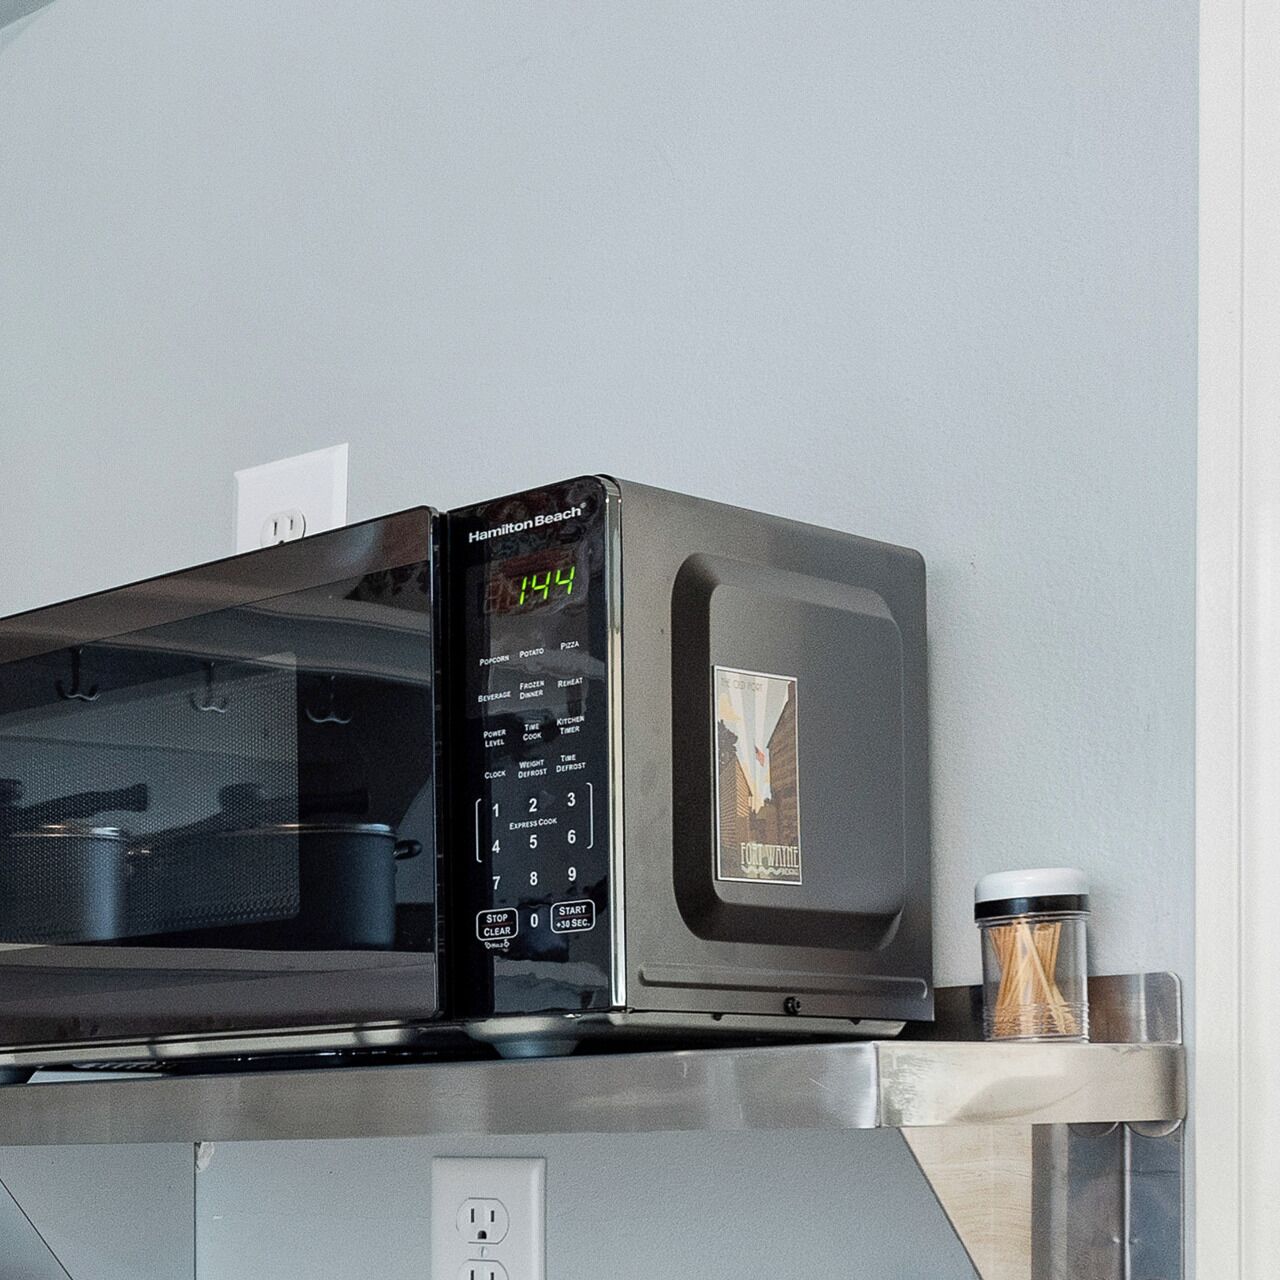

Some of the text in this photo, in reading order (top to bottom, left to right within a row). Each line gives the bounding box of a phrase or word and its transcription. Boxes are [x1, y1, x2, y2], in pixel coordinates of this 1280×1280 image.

[468, 506, 582, 543] Hamilton Beach
[561, 641, 579, 650] PIZZA
[520, 648, 544, 658] POTATO
[480, 655, 509, 666] POPCORN
[557, 678, 583, 688] REHEAT
[478, 691, 511, 702] BEVERAGE
[557, 716, 584, 726] KITCHEN
[525, 723, 539, 731] TIME
[560, 726, 580, 735] TIMER
[484, 729, 506, 738] POWER
[523, 732, 541, 741] COOK
[485, 739, 504, 748] LEVEL
[561, 754, 576, 762] TIME
[556, 762, 586, 773] DEFROST
[484, 770, 506, 779] CLOCK
[518, 768, 547, 779] DEFROST
[529, 798, 537, 812] 2
[567, 792, 576, 807] 3
[492, 803, 499, 817] 1
[509, 818, 557, 830] EXPRESS COOK
[529, 834, 537, 849] 5
[567, 829, 576, 844] 6
[491, 839, 500, 853] 4
[530, 871, 538, 886] 8
[568, 866, 577, 881] 9
[492, 875, 500, 890] 7
[559, 905, 586, 915] START
[486, 913, 508, 923] STOP
[530, 913, 539, 927] 0
[571, 918, 591, 928] SEC.
[484, 926, 511, 937] CLEAR
